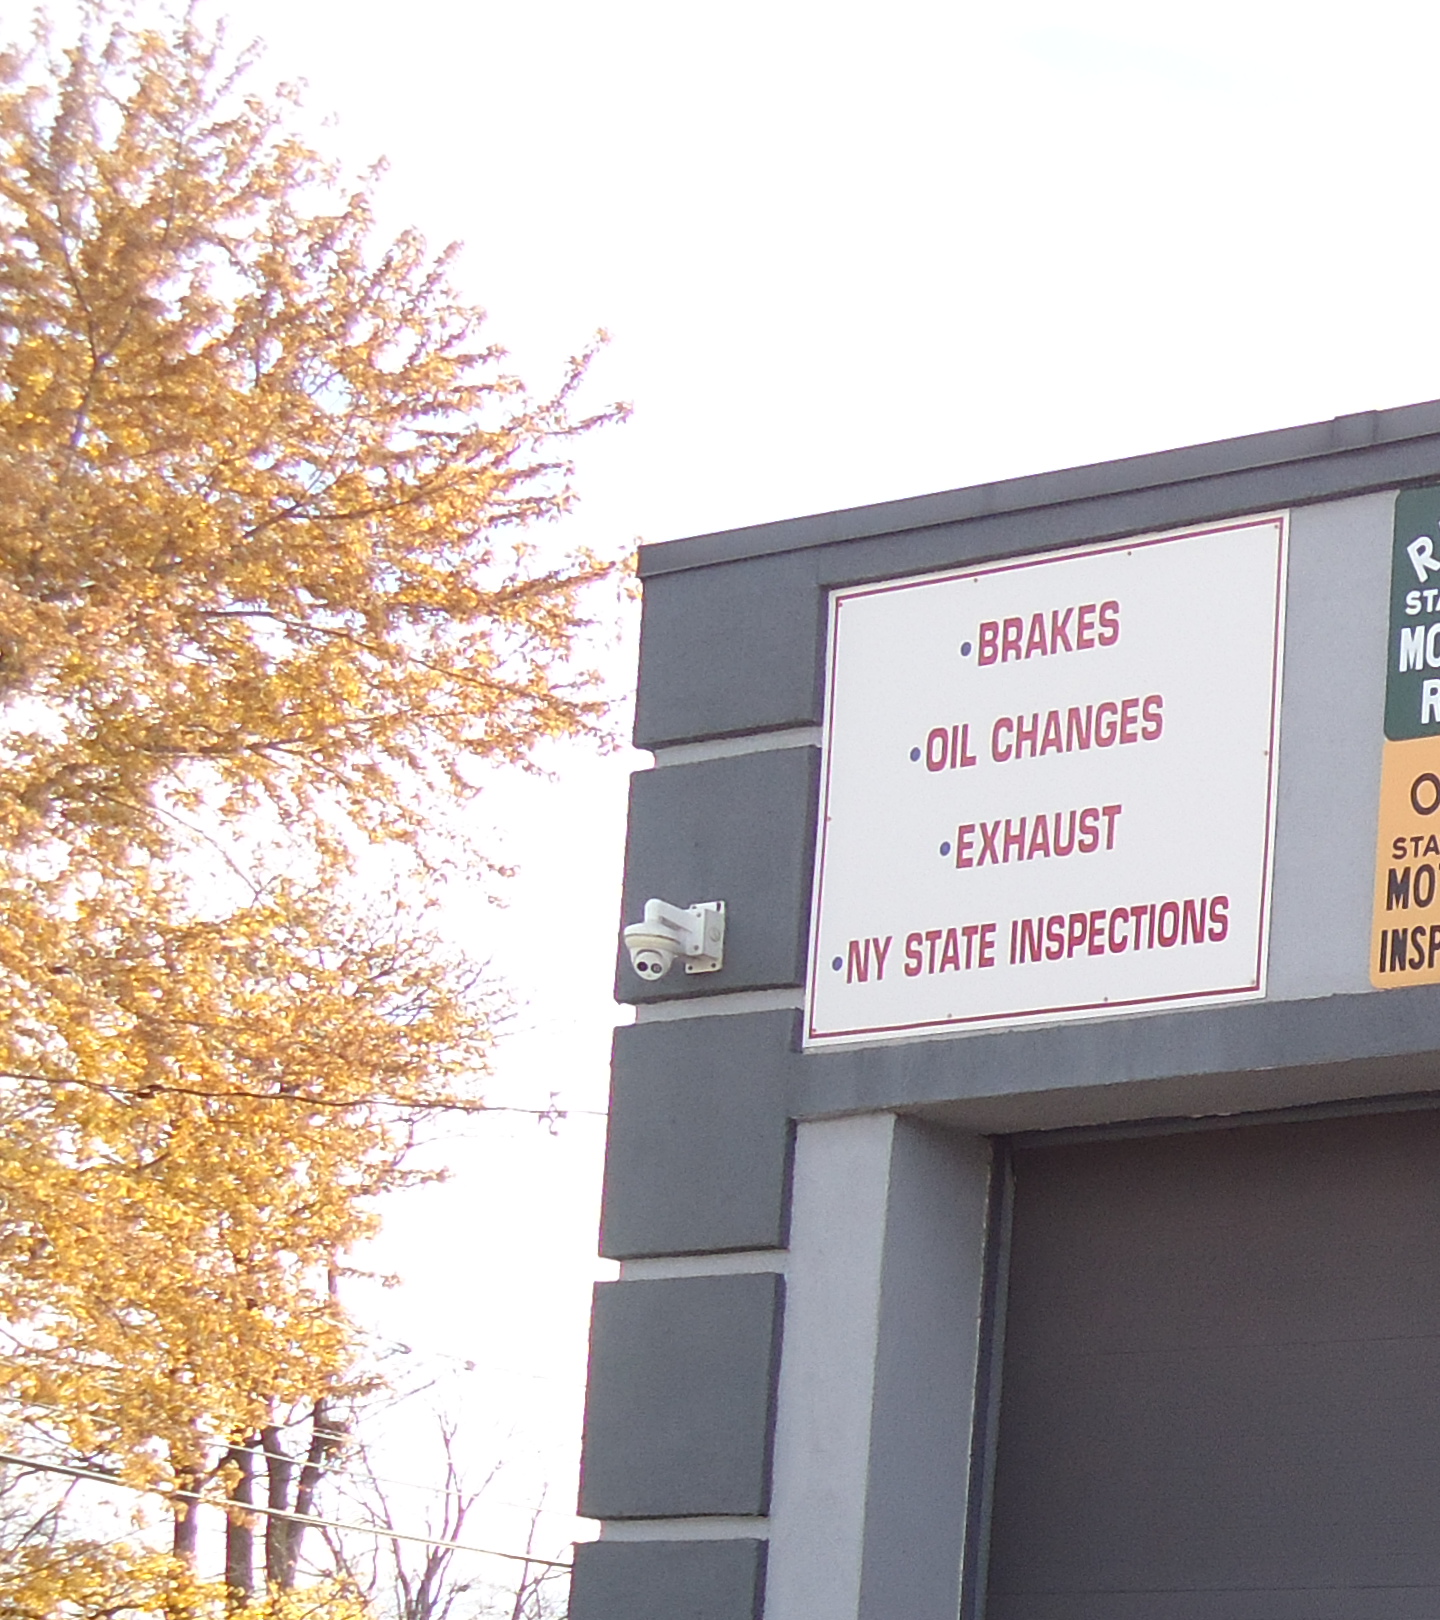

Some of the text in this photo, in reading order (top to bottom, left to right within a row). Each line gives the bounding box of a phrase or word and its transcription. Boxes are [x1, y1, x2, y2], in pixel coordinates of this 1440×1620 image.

[977, 600, 1120, 666] BRAKES
[925, 694, 1164, 772] OIL CHANGES
[955, 804, 1122, 869] EXHAUST
[846, 895, 1230, 984] NY STATE INSPECTIONS
